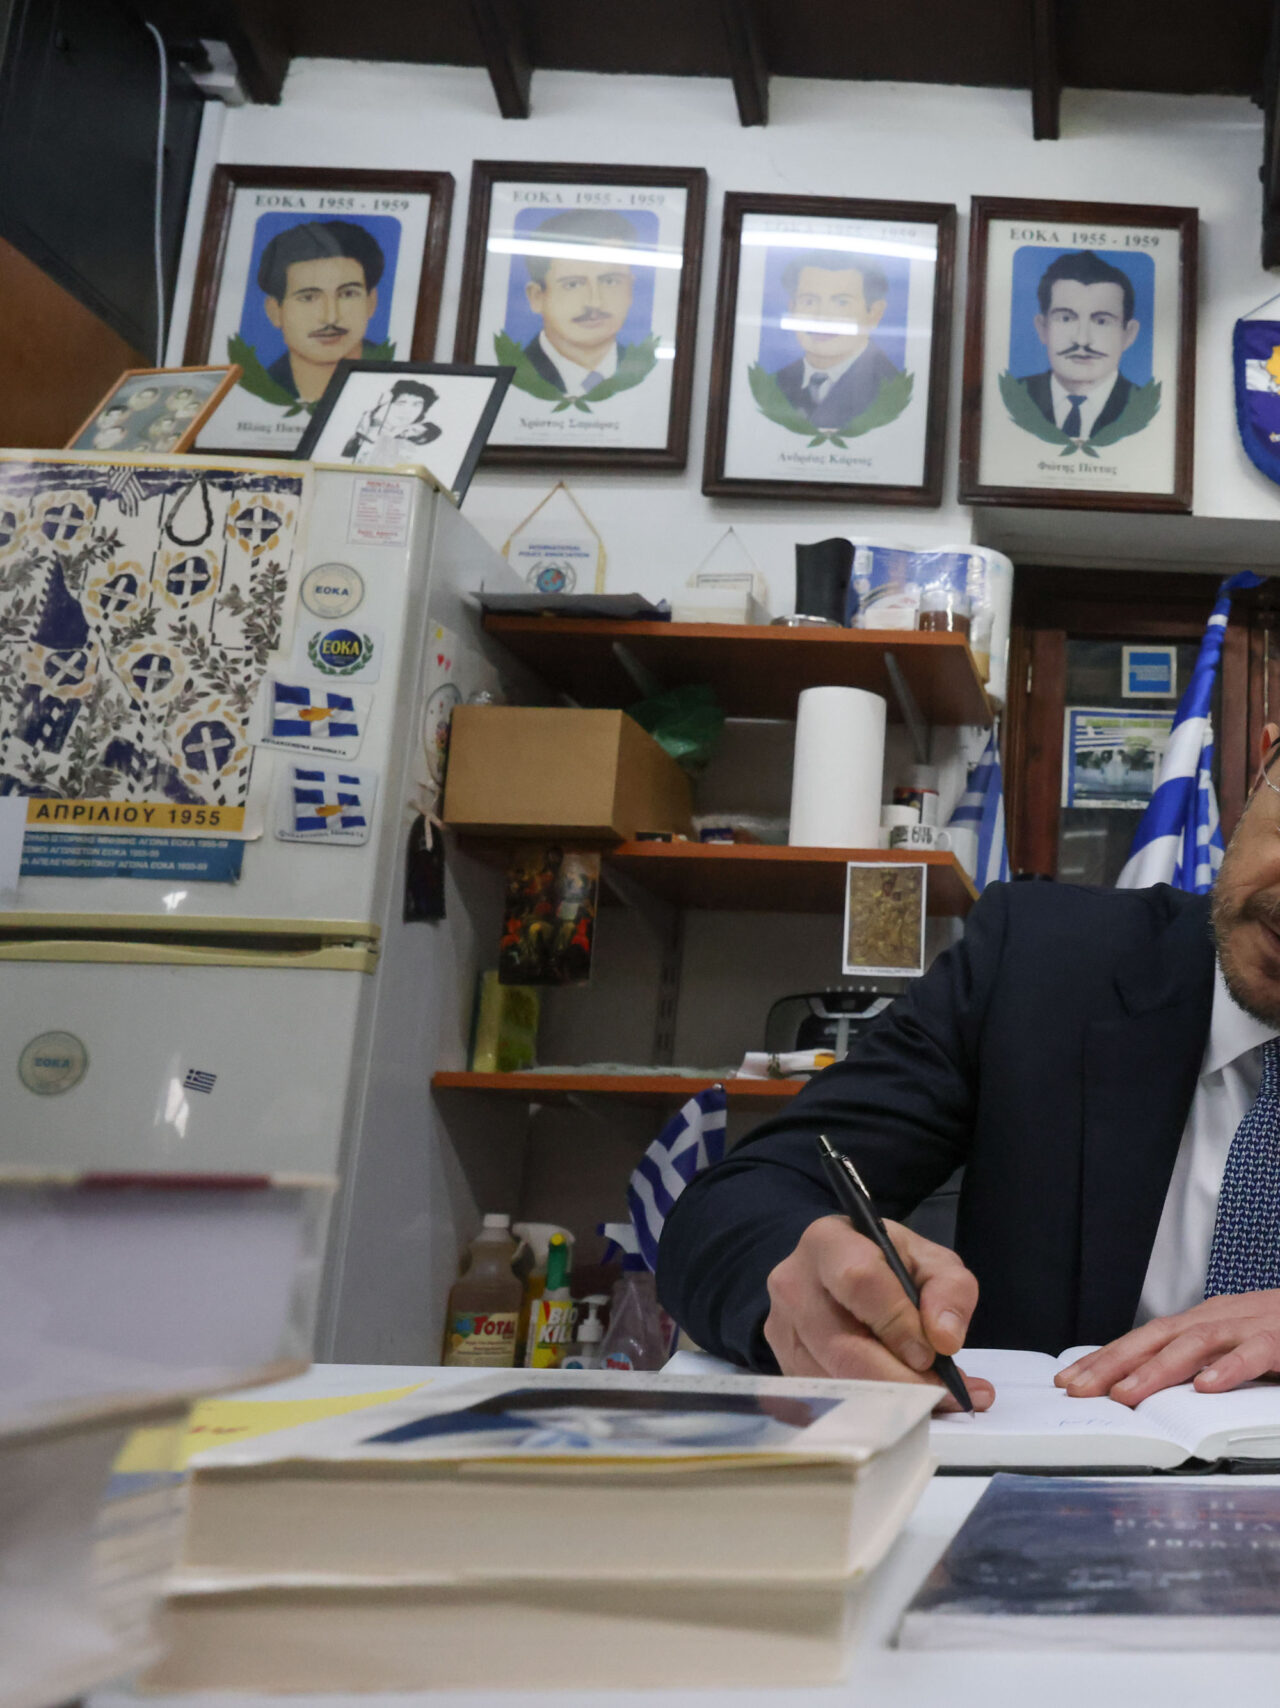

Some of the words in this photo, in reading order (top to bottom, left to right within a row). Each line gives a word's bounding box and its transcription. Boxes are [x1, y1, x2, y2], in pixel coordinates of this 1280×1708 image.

[319, 197, 354, 209] 1955
[374, 199, 410, 211] 1959
[1010, 228, 1060, 243] ΕΟΚΑ
[1072, 231, 1106, 245] 1955
[1125, 234, 1160, 247] 1959
[315, 585, 349, 596] ΕΟΚΑ
[322, 640, 360, 655] ΕΟΚΑ
[36, 804, 155, 823] ΑΠΡΙΛΙΟΥ
[168, 810, 221, 826] 1955
[171, 839, 196, 848] ΕΟΚΑ
[102, 848, 127, 857] ΕΟΚΑ
[151, 862, 175, 870] ΕΟΚΑ
[549, 1308, 578, 1324] BIO
[473, 1316, 514, 1336] TOTAL
